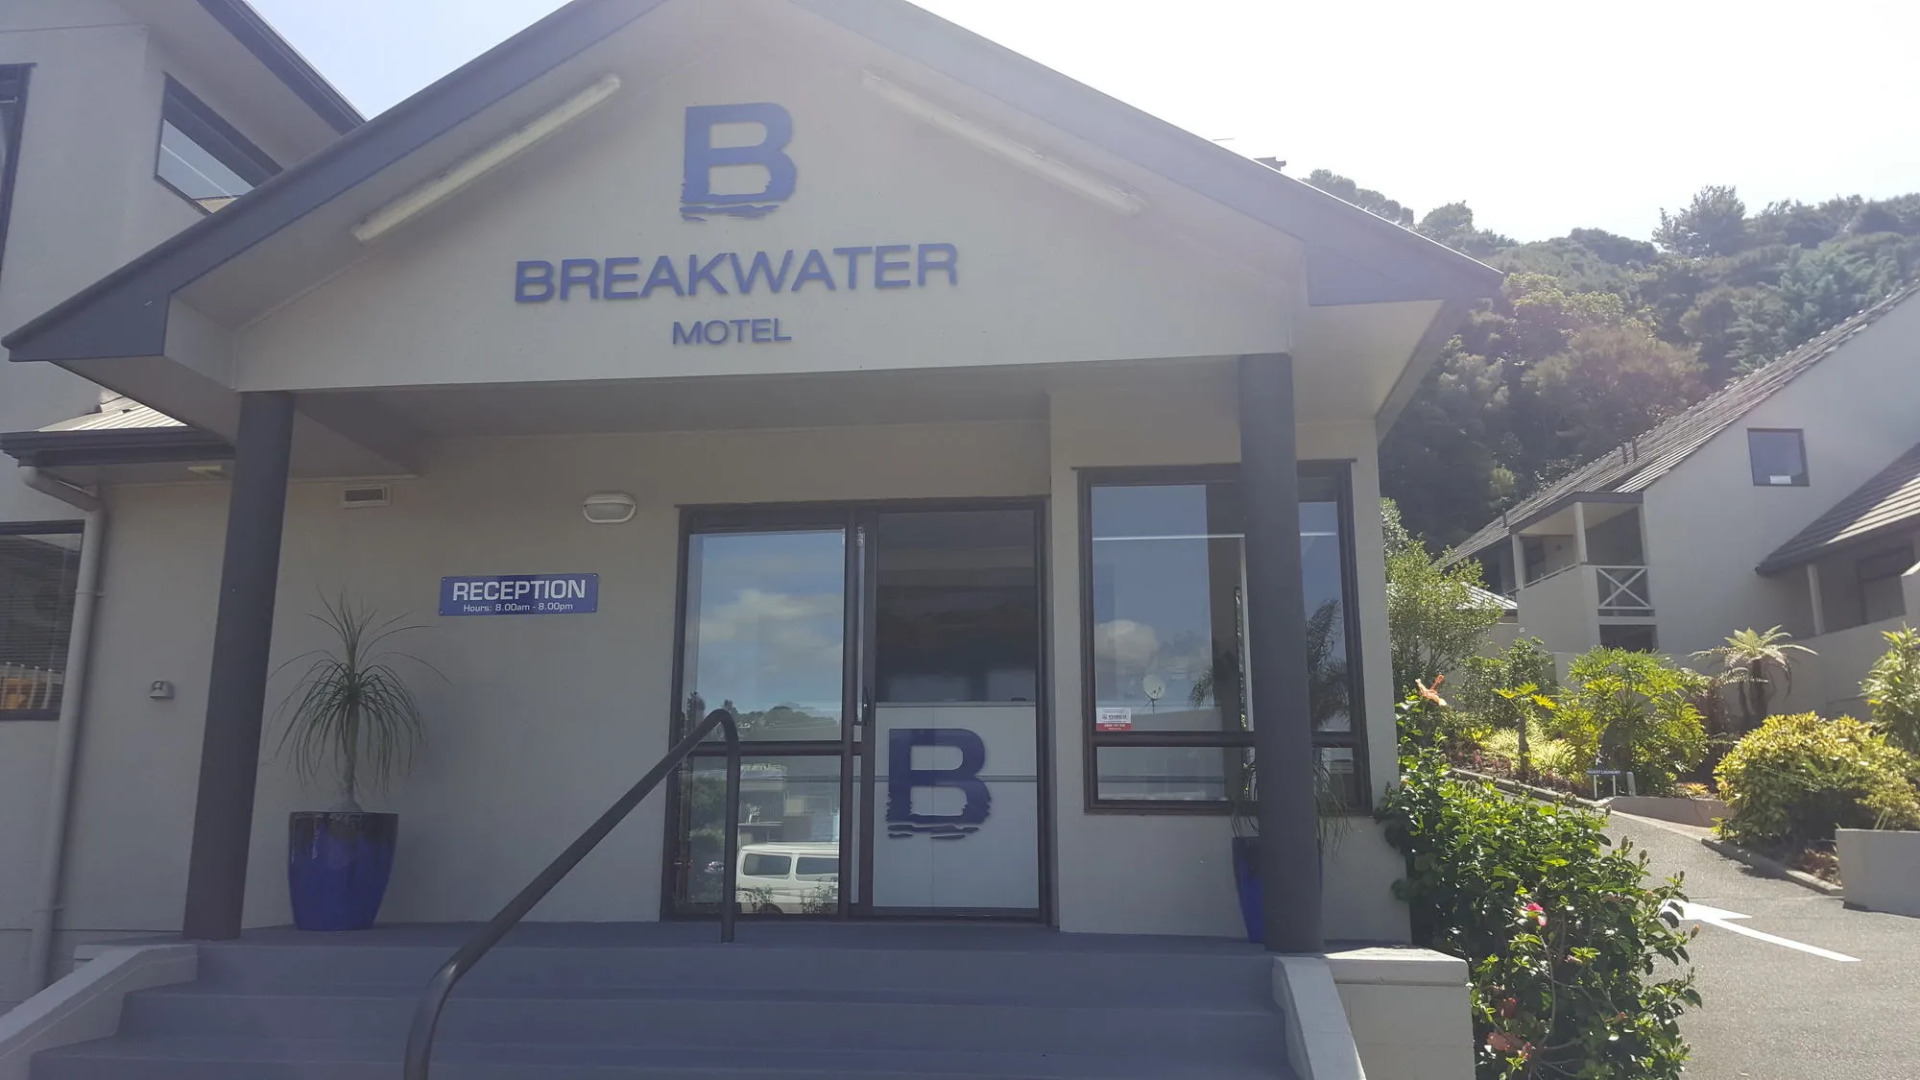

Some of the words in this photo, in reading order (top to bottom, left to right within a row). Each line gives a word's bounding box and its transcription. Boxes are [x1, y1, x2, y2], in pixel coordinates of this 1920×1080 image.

[680, 102, 797, 221] B
[514, 243, 958, 304] BREAKWATER
[672, 318, 792, 346] MOTEL
[453, 579, 586, 601] RECEPTION
[463, 604, 491, 612] Hours:
[495, 603, 530, 612] 8.00am
[538, 602, 573, 612] 8.00pm
[886, 728, 991, 840] B
